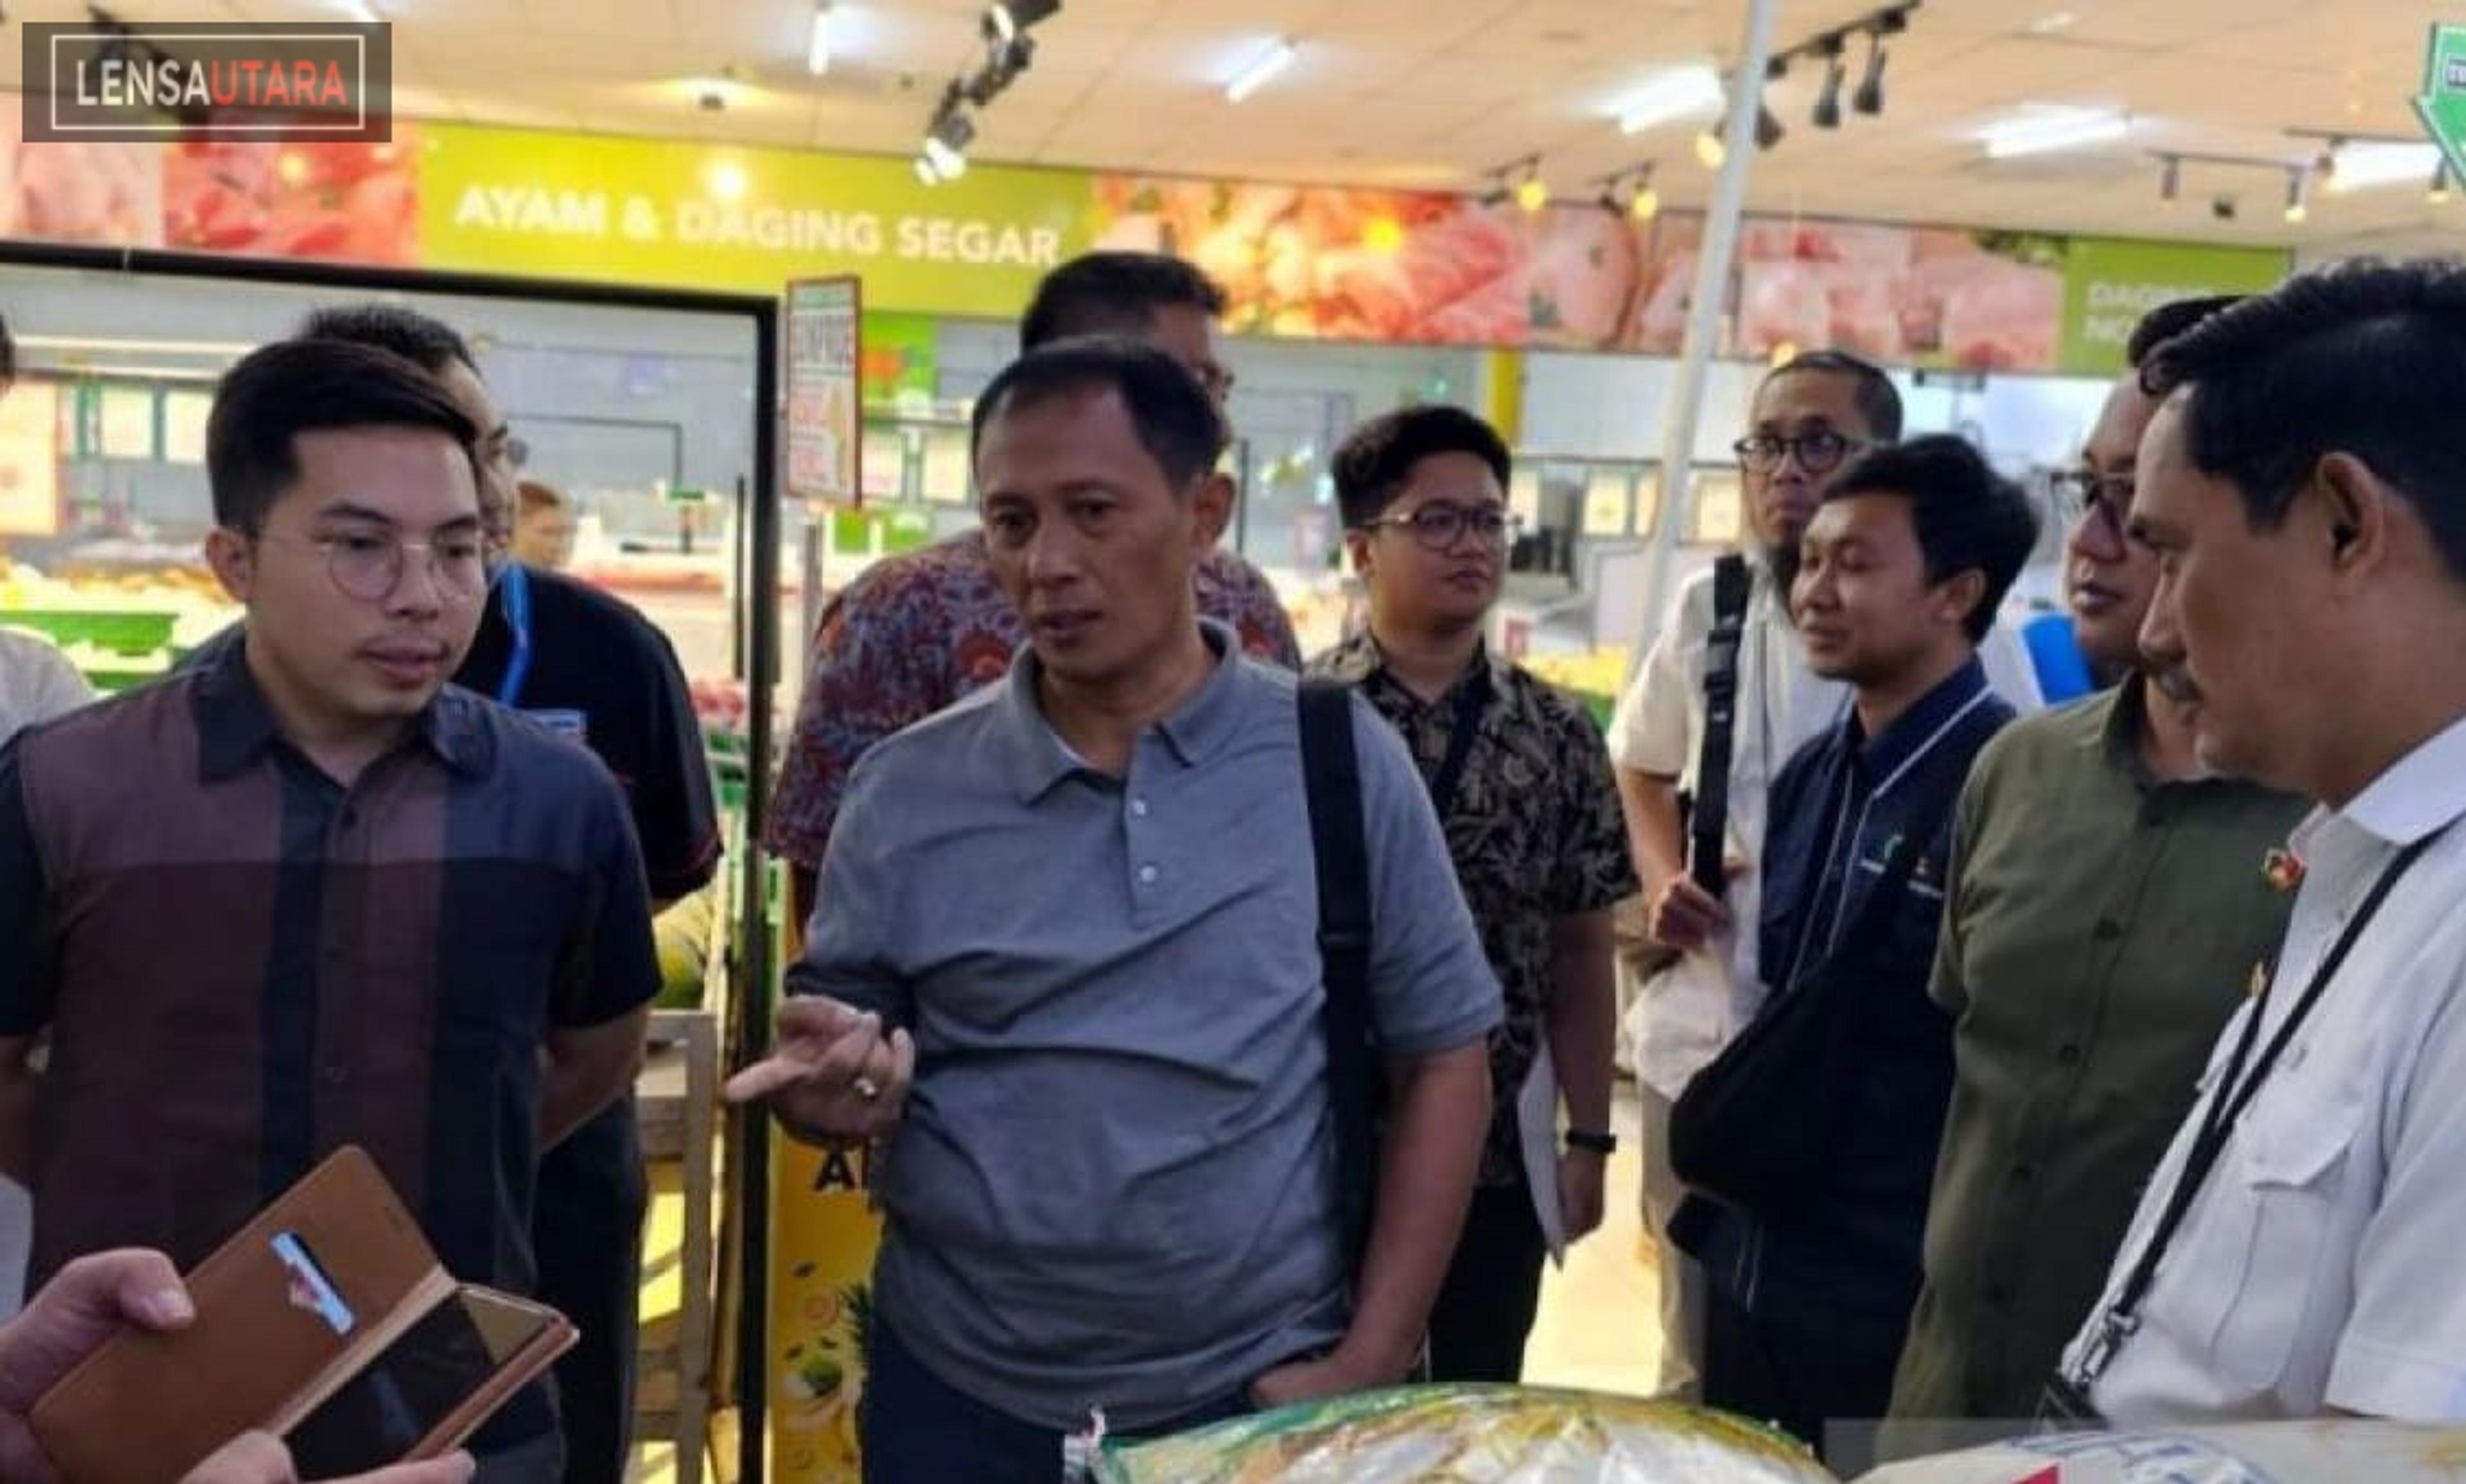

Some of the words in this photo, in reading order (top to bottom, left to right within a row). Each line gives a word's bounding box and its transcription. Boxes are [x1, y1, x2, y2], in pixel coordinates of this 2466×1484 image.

[455, 186, 605, 235] AYAM
[620, 195, 658, 240] &
[676, 201, 883, 254] DAGING
[896, 216, 1060, 267] SEGAR
